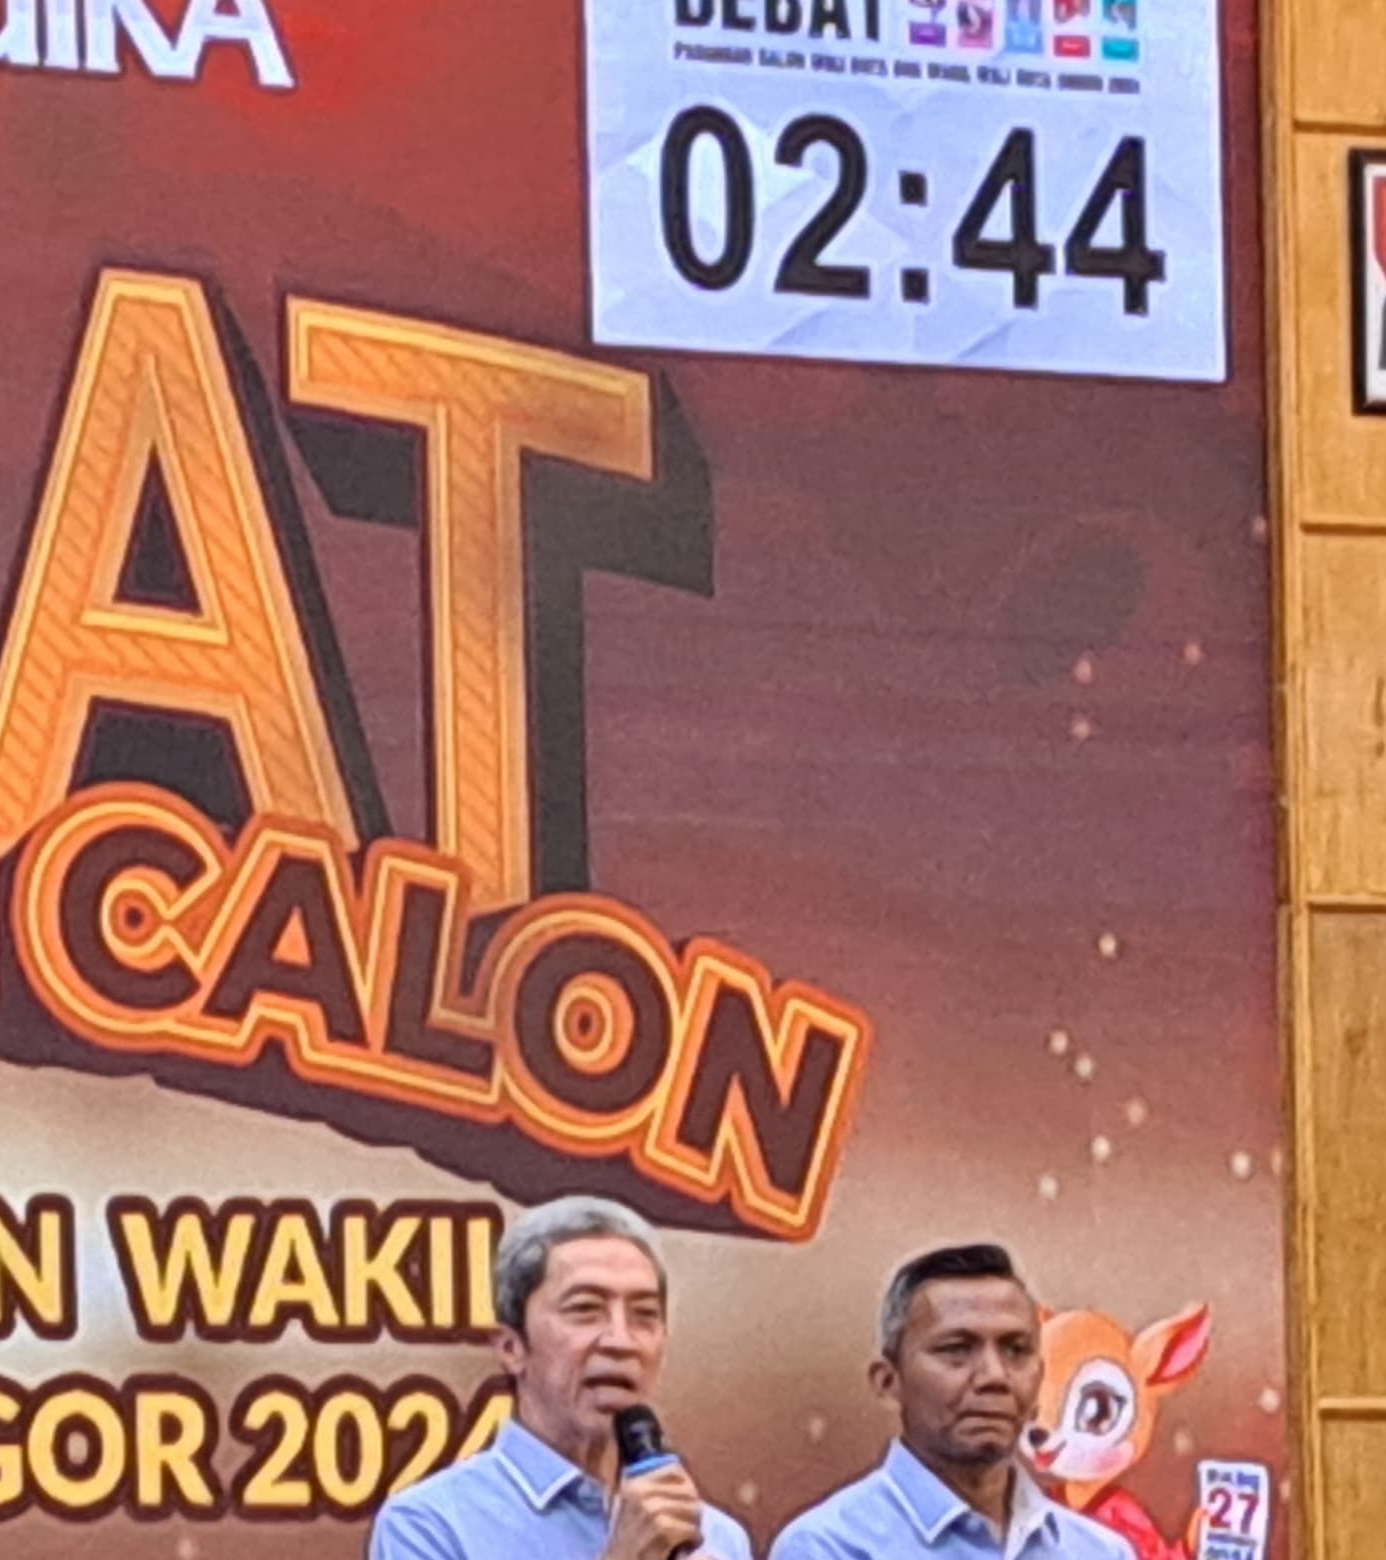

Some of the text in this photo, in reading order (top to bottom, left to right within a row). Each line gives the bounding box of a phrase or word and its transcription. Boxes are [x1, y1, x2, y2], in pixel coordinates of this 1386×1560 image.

[660, 104, 1166, 316] 02:44
[6, 779, 868, 1239] CALON
[1207, 1486, 1260, 1535] 27
